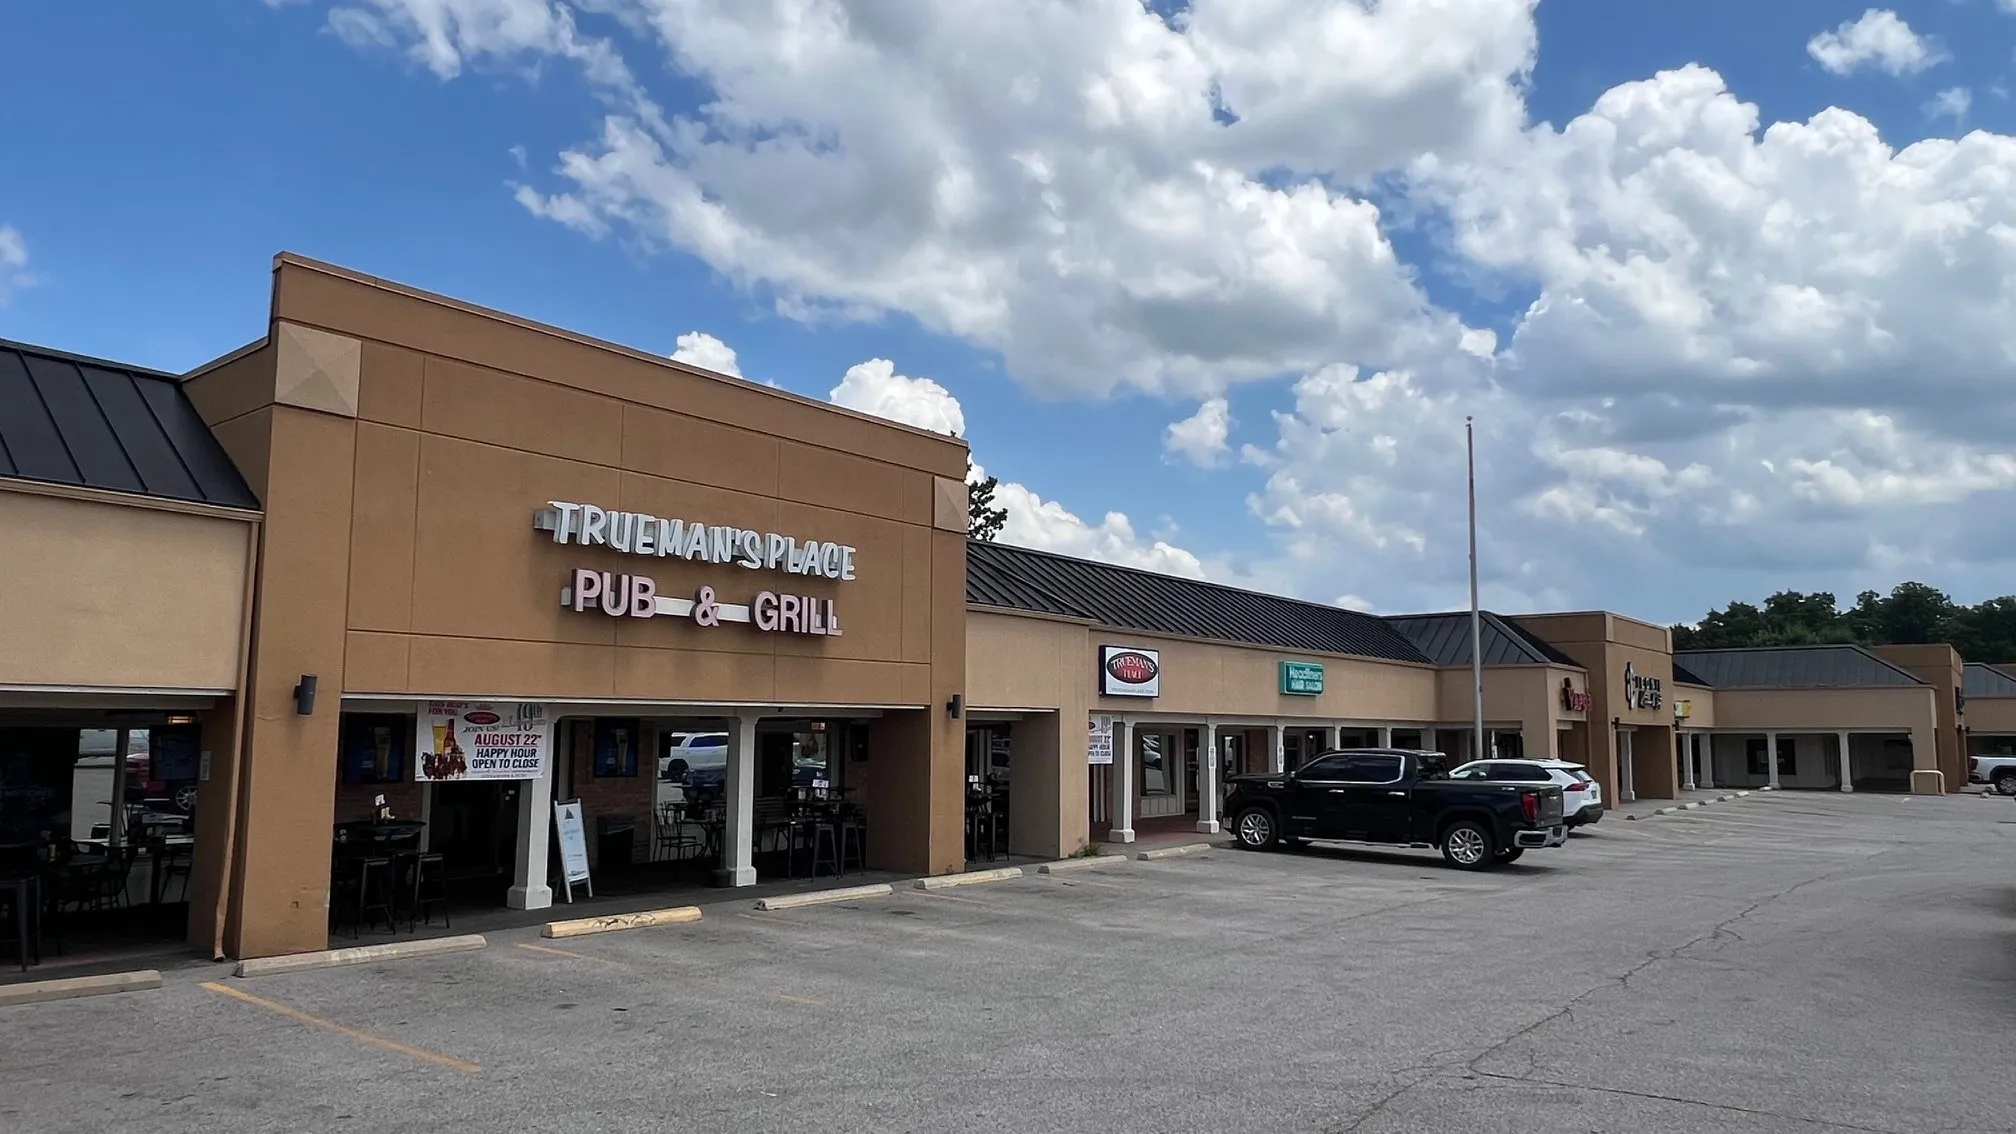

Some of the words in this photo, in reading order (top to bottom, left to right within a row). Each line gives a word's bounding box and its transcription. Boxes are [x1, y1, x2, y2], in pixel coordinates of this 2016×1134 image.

[547, 501, 762, 570] TRUEMAN'S
[764, 533, 856, 581] PLACE
[571, 568, 656, 618] PUB
[692, 586, 719, 627] &
[754, 591, 842, 636] GRILL
[428, 707, 443, 715] FOR
[463, 725, 484, 733] JOIN
[474, 733, 522, 746] AUGUST
[476, 748, 509, 758] HAPPY
[510, 748, 538, 758] HOUR
[472, 758, 497, 769] OPEN
[498, 758, 511, 768] TO
[512, 758, 540, 768] CLOSE
